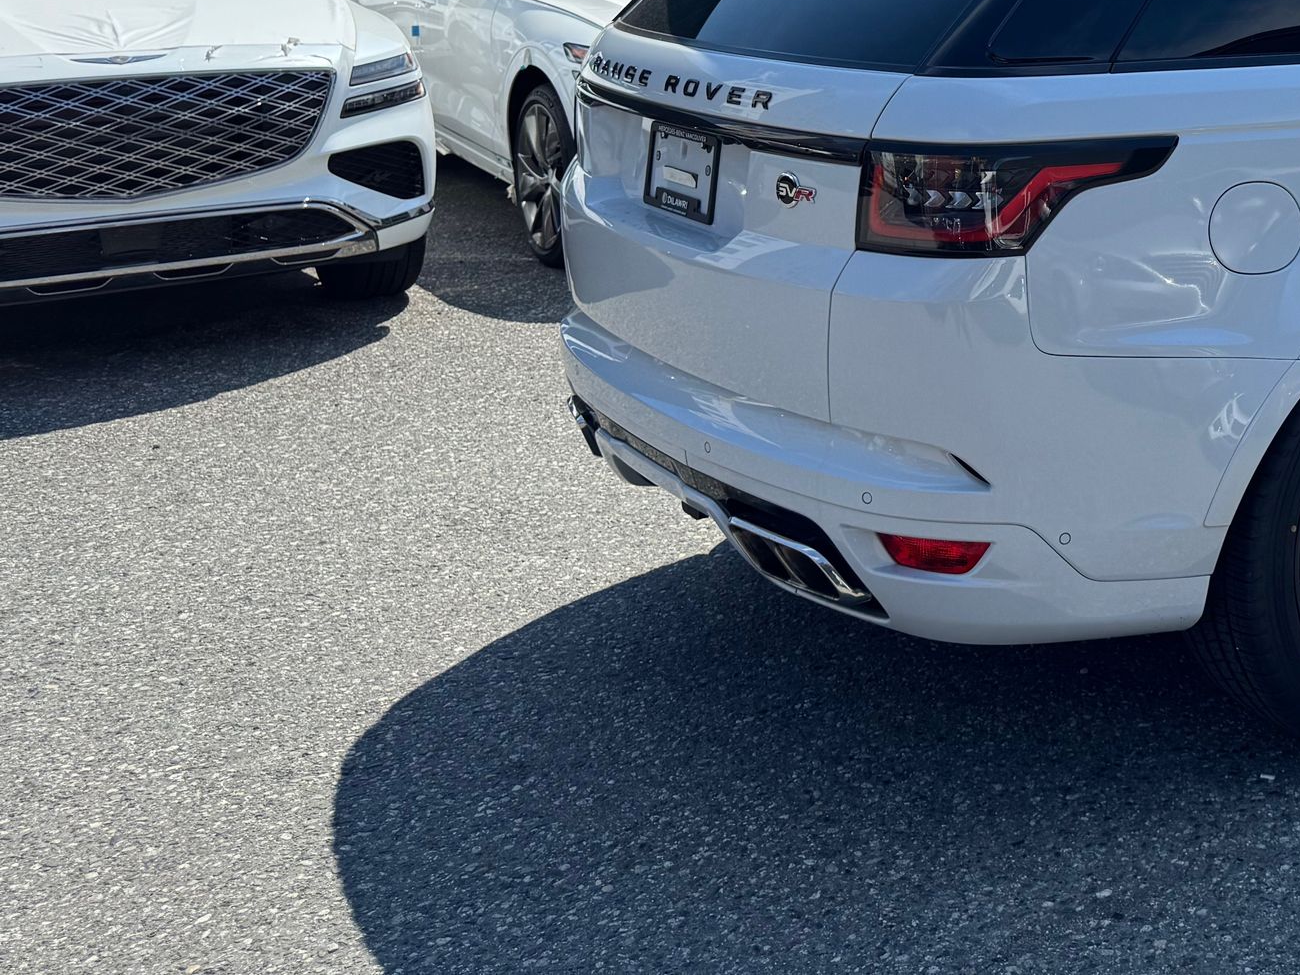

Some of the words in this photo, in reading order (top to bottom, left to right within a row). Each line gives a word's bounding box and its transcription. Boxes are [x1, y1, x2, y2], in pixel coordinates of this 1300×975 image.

[592, 56, 652, 87] RANGE
[664, 74, 772, 110] ROVER
[658, 126, 685, 138] MERCEDES-BENZ
[686, 131, 707, 142] VANCOUVER
[778, 182, 817, 202] SVR
[667, 195, 688, 209] DILAWRI
